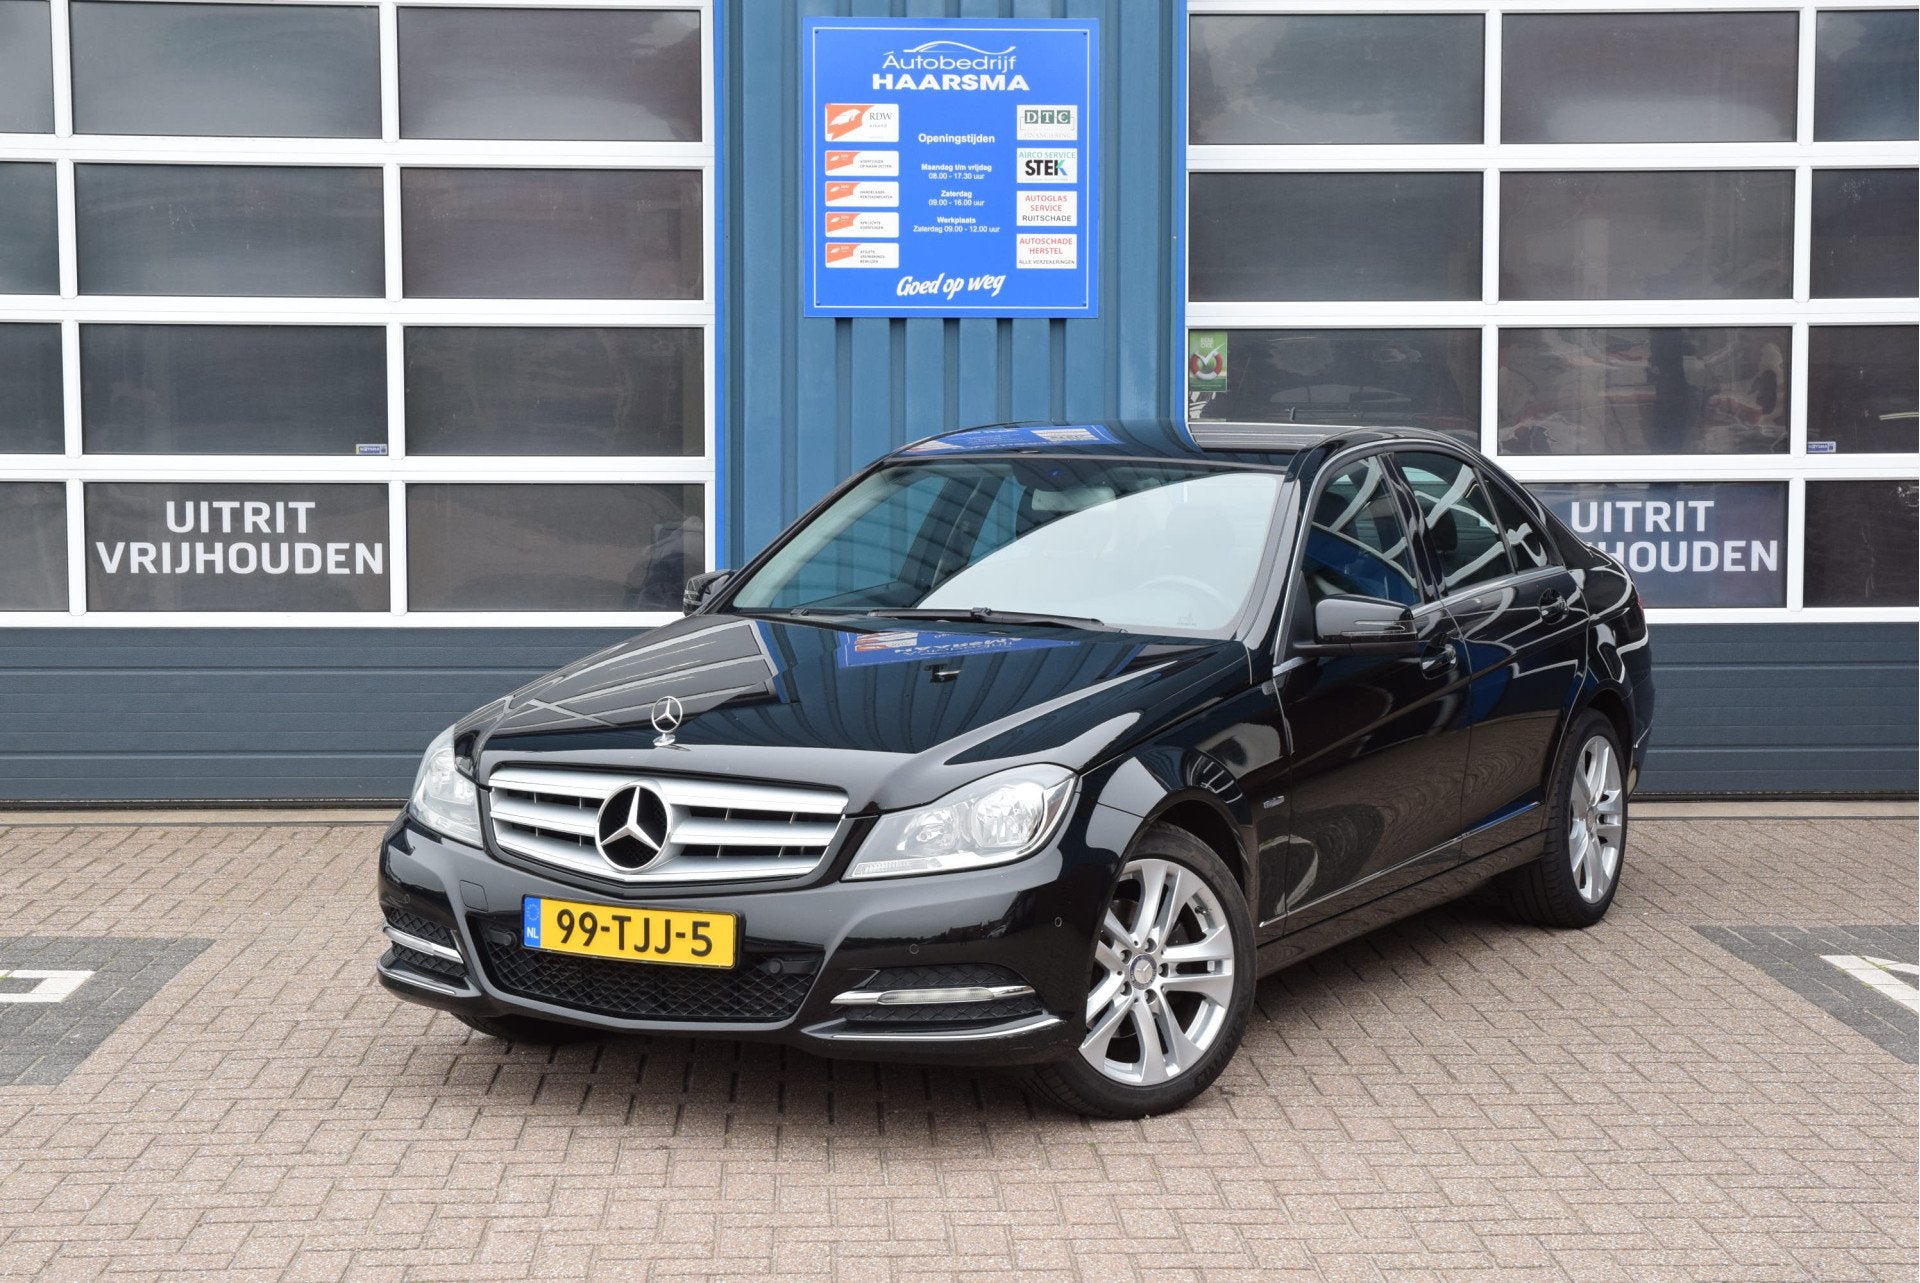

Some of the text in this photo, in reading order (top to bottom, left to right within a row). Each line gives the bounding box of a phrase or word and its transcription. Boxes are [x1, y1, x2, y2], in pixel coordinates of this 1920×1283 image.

[872, 74, 1030, 91] HAARSMA
[869, 112, 893, 120] RDW
[1025, 110, 1070, 124] DTC
[918, 133, 995, 145] Openingstijden
[1019, 151, 1076, 159] AIRCO SERVICE
[921, 163, 953, 172] Maandag
[968, 163, 992, 172] vrijdag
[1025, 159, 1067, 176] STEK
[928, 172, 948, 180] 08.00
[954, 172, 972, 180] 17.30
[941, 190, 972, 198] Zaterdag
[937, 216, 976, 224] Werkplaats
[913, 225, 943, 233] Zaterdag
[1029, 247, 1063, 255] HERSTEL
[896, 272, 1007, 300] Goed op weg
[166, 501, 316, 533] UITRIT
[1571, 500, 1715, 534] UITRIT
[95, 541, 383, 575] VRIJHOUDEN
[526, 926, 539, 939] NL
[556, 908, 713, 958] 99-TJJ-5
